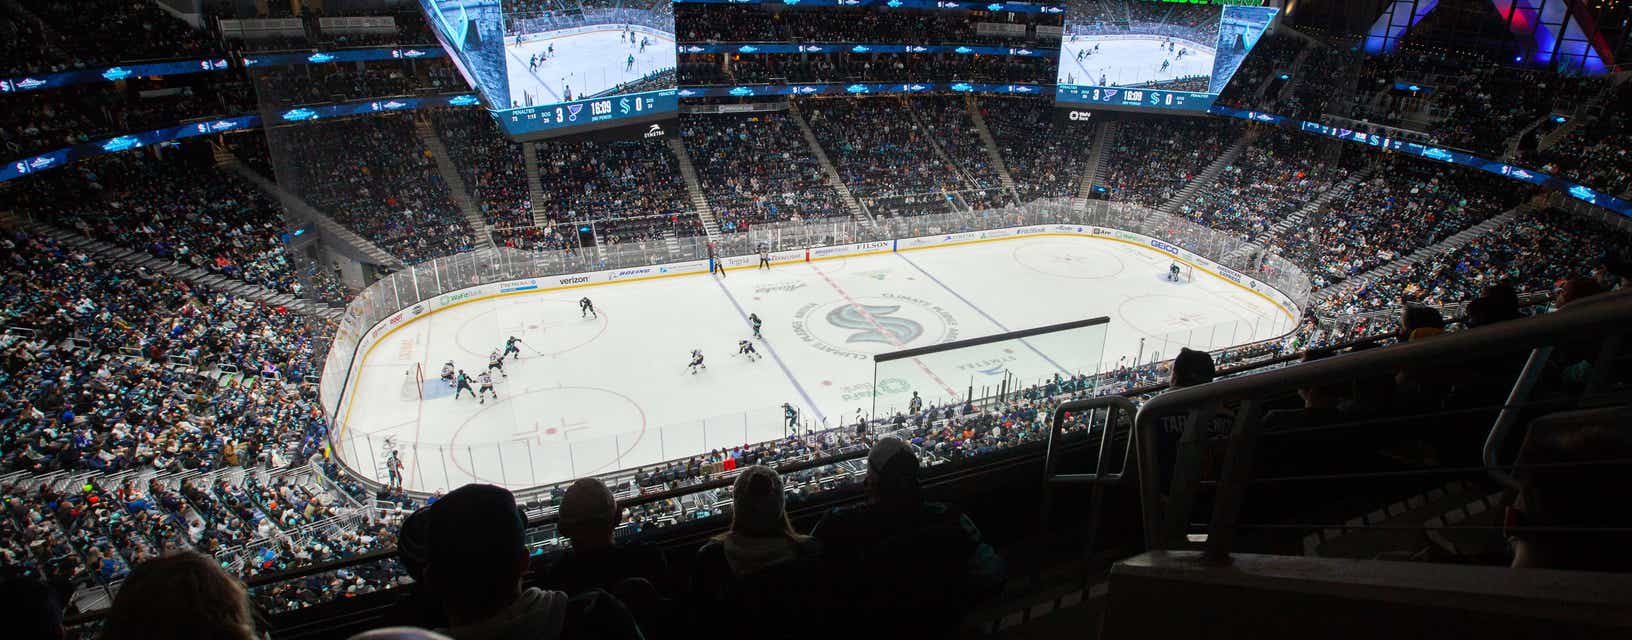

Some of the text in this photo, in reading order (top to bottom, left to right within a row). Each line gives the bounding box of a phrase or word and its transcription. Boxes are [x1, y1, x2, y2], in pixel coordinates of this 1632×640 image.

[1092, 88, 1100, 101] 3
[1123, 90, 1143, 102] 16:09
[1165, 93, 1173, 105] 0
[556, 97, 642, 123] 3 16:09 0
[856, 241, 888, 250] FILSON
[1151, 239, 1179, 255] GEICO
[559, 275, 590, 286] verizon
